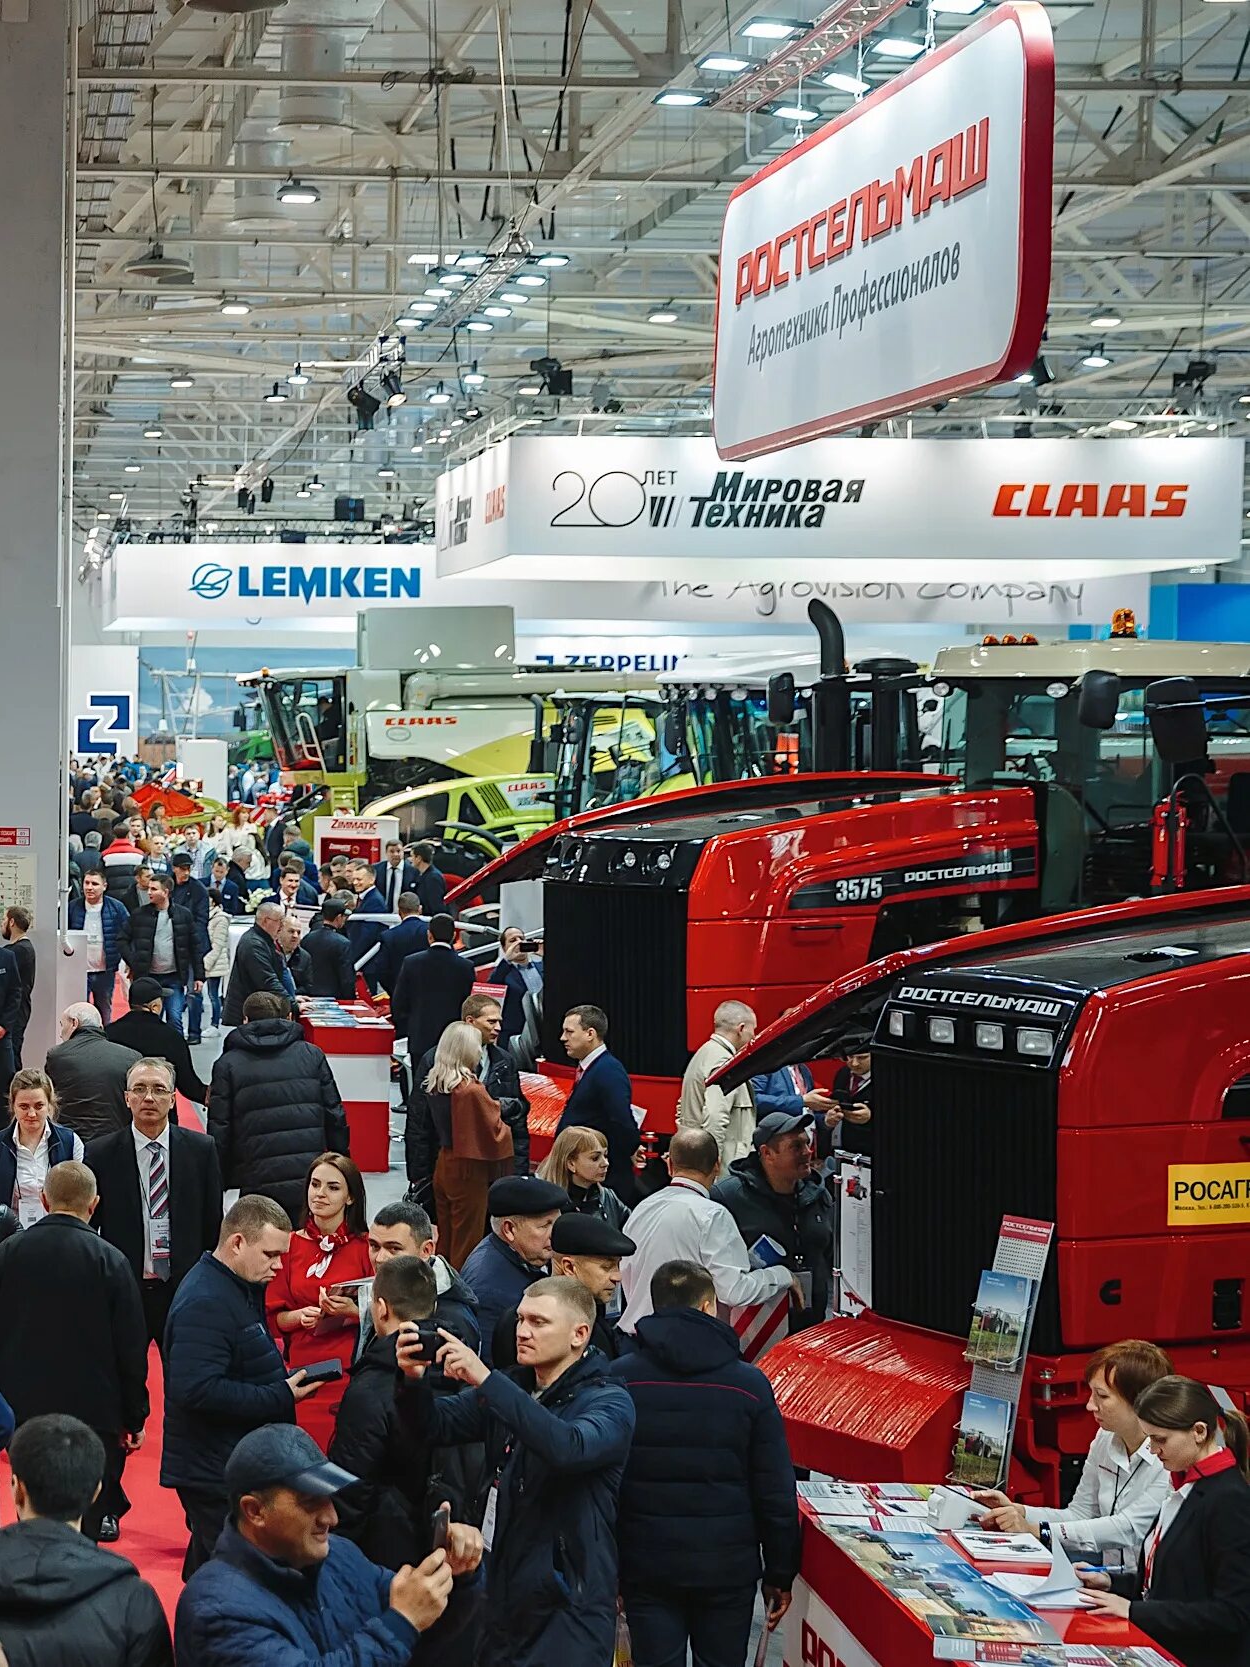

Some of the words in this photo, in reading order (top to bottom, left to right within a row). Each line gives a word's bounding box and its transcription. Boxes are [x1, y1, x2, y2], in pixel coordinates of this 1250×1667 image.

[736, 117, 989, 304] РОСТСЕЛЬМАШ
[747, 301, 829, 371] Агротехника
[830, 242, 960, 339] Профессионалов
[550, 471, 646, 527] 20
[641, 470, 678, 486] ЛЕТ
[708, 472, 865, 503] Мировая
[992, 483, 1188, 518] CLAAS
[690, 497, 826, 527] Техника
[238, 566, 421, 604] LEMKEN
[385, 716, 458, 726] CLAAS
[507, 782, 546, 793] CLAAS
[330, 819, 379, 830] ZIMMATIC
[903, 862, 1012, 884] РОСТСЕЛЬМАШ
[836, 877, 882, 901] 3575
[898, 986, 1061, 1017] РОСТСЕЛЬМАШ
